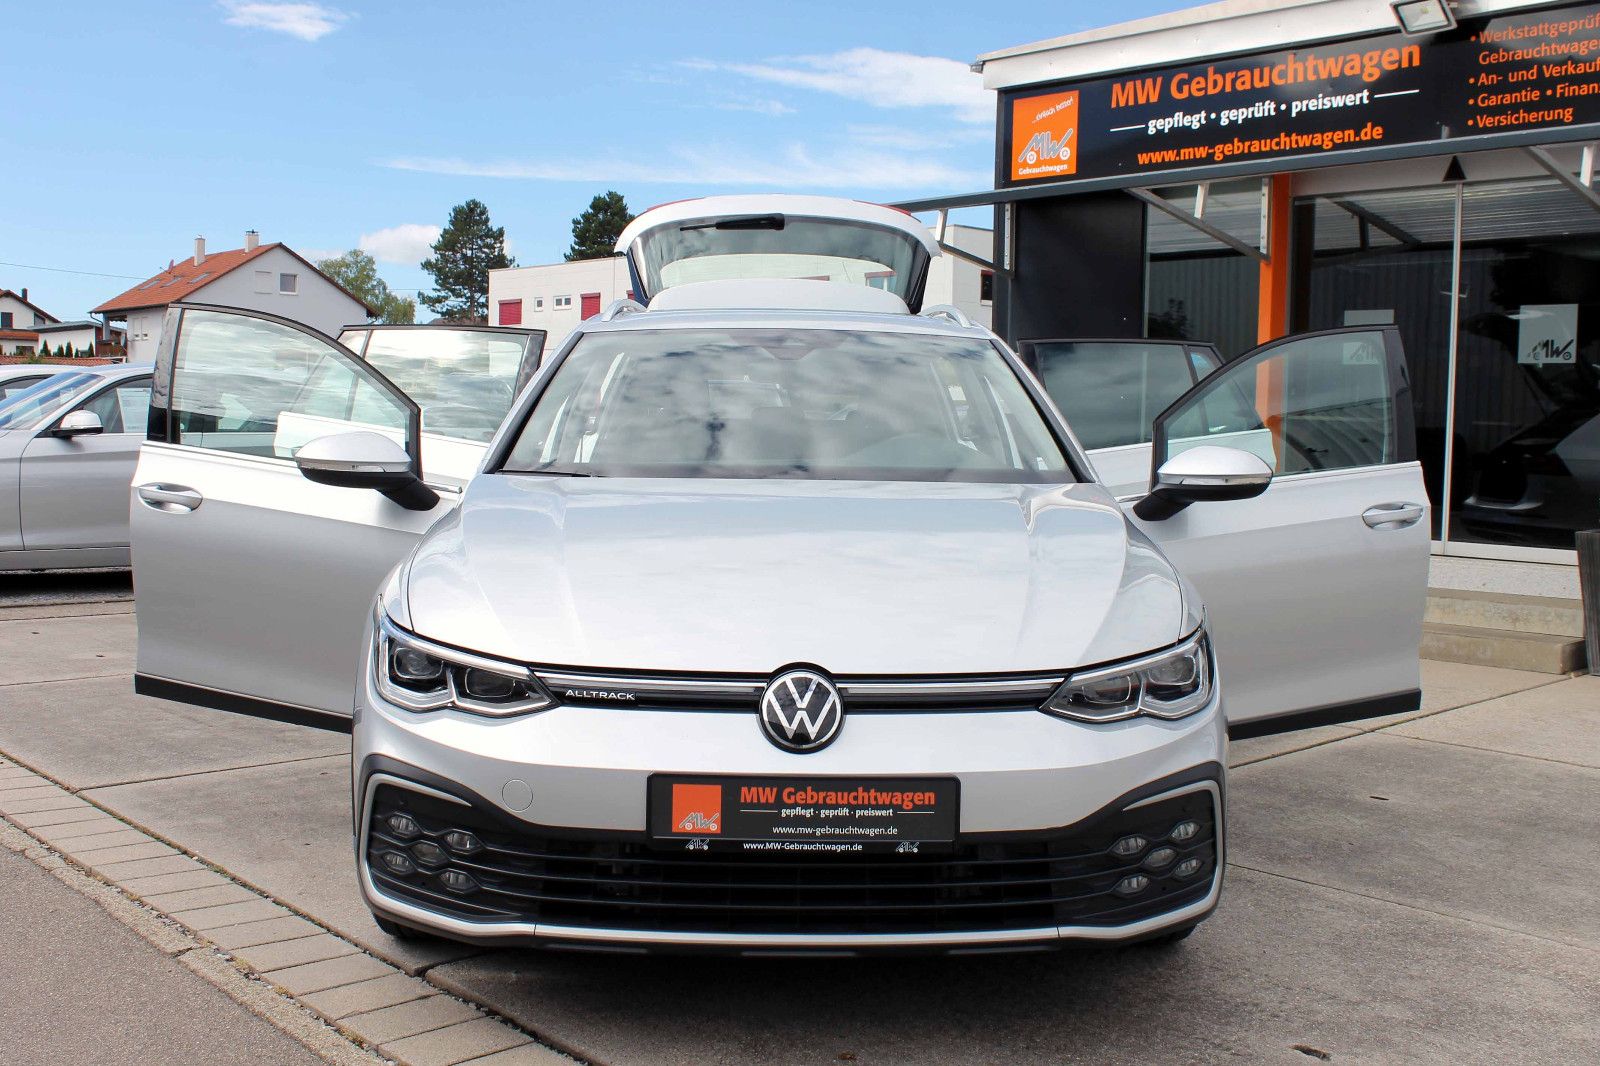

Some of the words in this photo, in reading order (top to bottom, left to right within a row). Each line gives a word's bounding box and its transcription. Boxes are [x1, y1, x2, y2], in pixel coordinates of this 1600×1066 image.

[1479, 38, 1600, 65] Gebrauchtwage
[1111, 76, 1163, 109] MW
[1170, 44, 1421, 99] Gebrauchtwagen
[1478, 73, 1503, 87] An-
[1508, 66, 1537, 83] und
[1477, 87, 1540, 107] Garantie
[1556, 82, 1600, 98] Finan
[1147, 110, 1207, 135] gepflegt
[1220, 100, 1276, 126] geprüft
[1291, 89, 1369, 117] preiswert
[1476, 107, 1574, 129] Versicherung
[1137, 122, 1384, 165] www.mw-gebrauchtwagen.de
[1018, 163, 1068, 175] Gebrauchtwagen
[565, 688, 635, 701] ALLTRACK
[741, 786, 777, 804] MW
[782, 786, 935, 810] Gebrauchtwagen
[781, 806, 814, 818] gepflegt
[820, 807, 849, 818] geprüft
[855, 807, 893, 818] preiswert
[772, 825, 898, 837] www.mw-gebrauchtwagen.de
[743, 841, 863, 853] www.MW-Gebrauchtwagen.de
